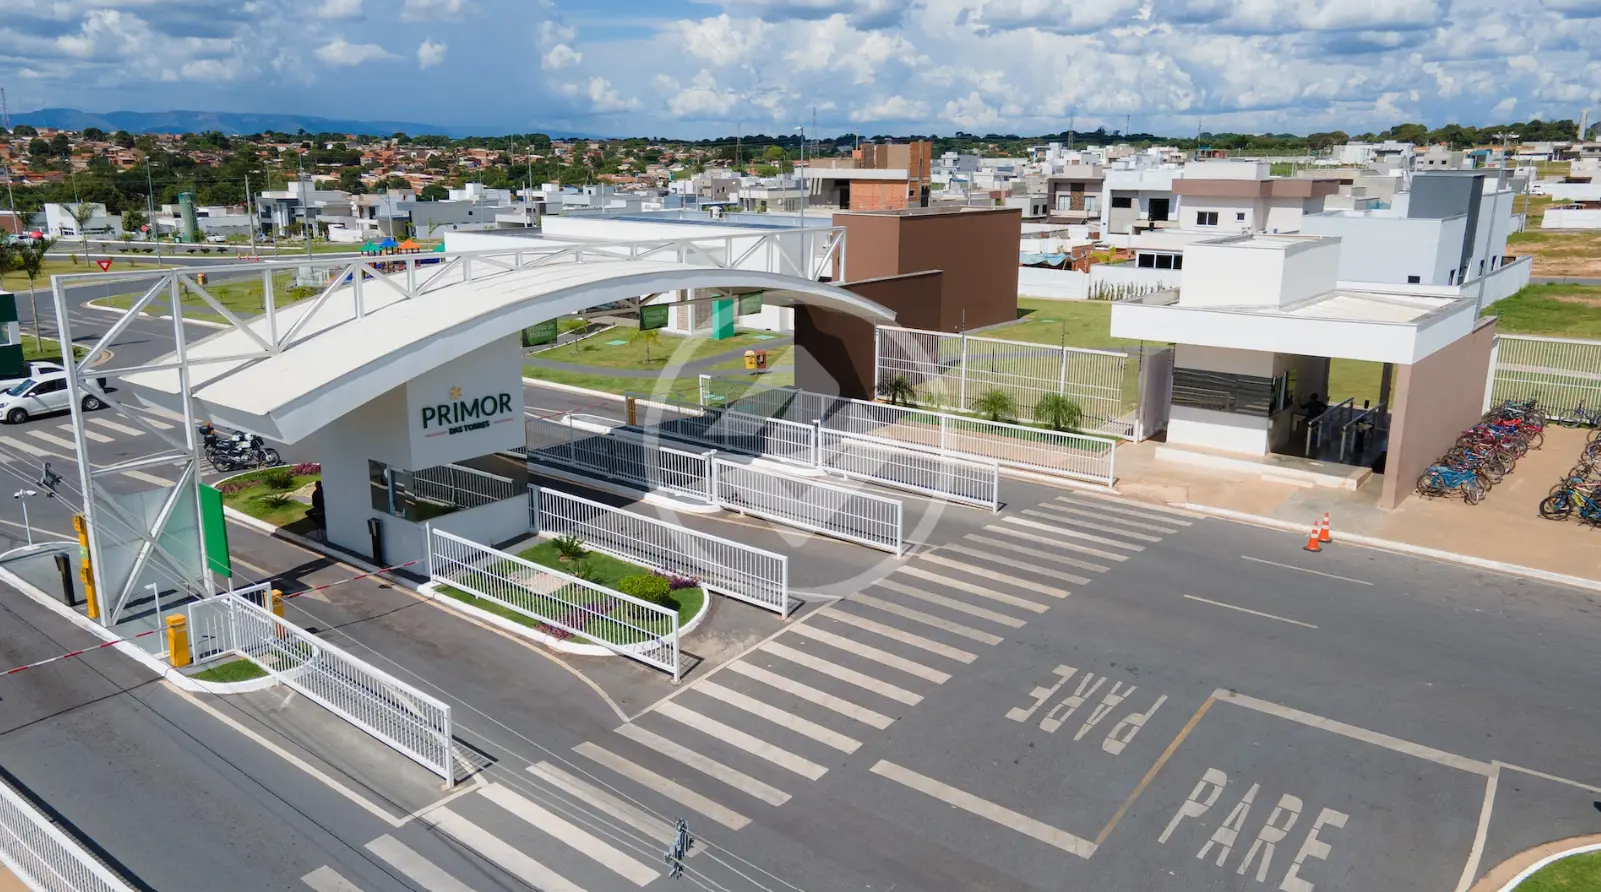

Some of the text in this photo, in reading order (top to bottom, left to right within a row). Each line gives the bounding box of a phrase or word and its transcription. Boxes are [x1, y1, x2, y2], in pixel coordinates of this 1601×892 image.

[422, 393, 512, 429] PRIMOR
[449, 426, 463, 434] DAS
[1005, 664, 1168, 755] PARE
[1158, 767, 1349, 892] PARE
